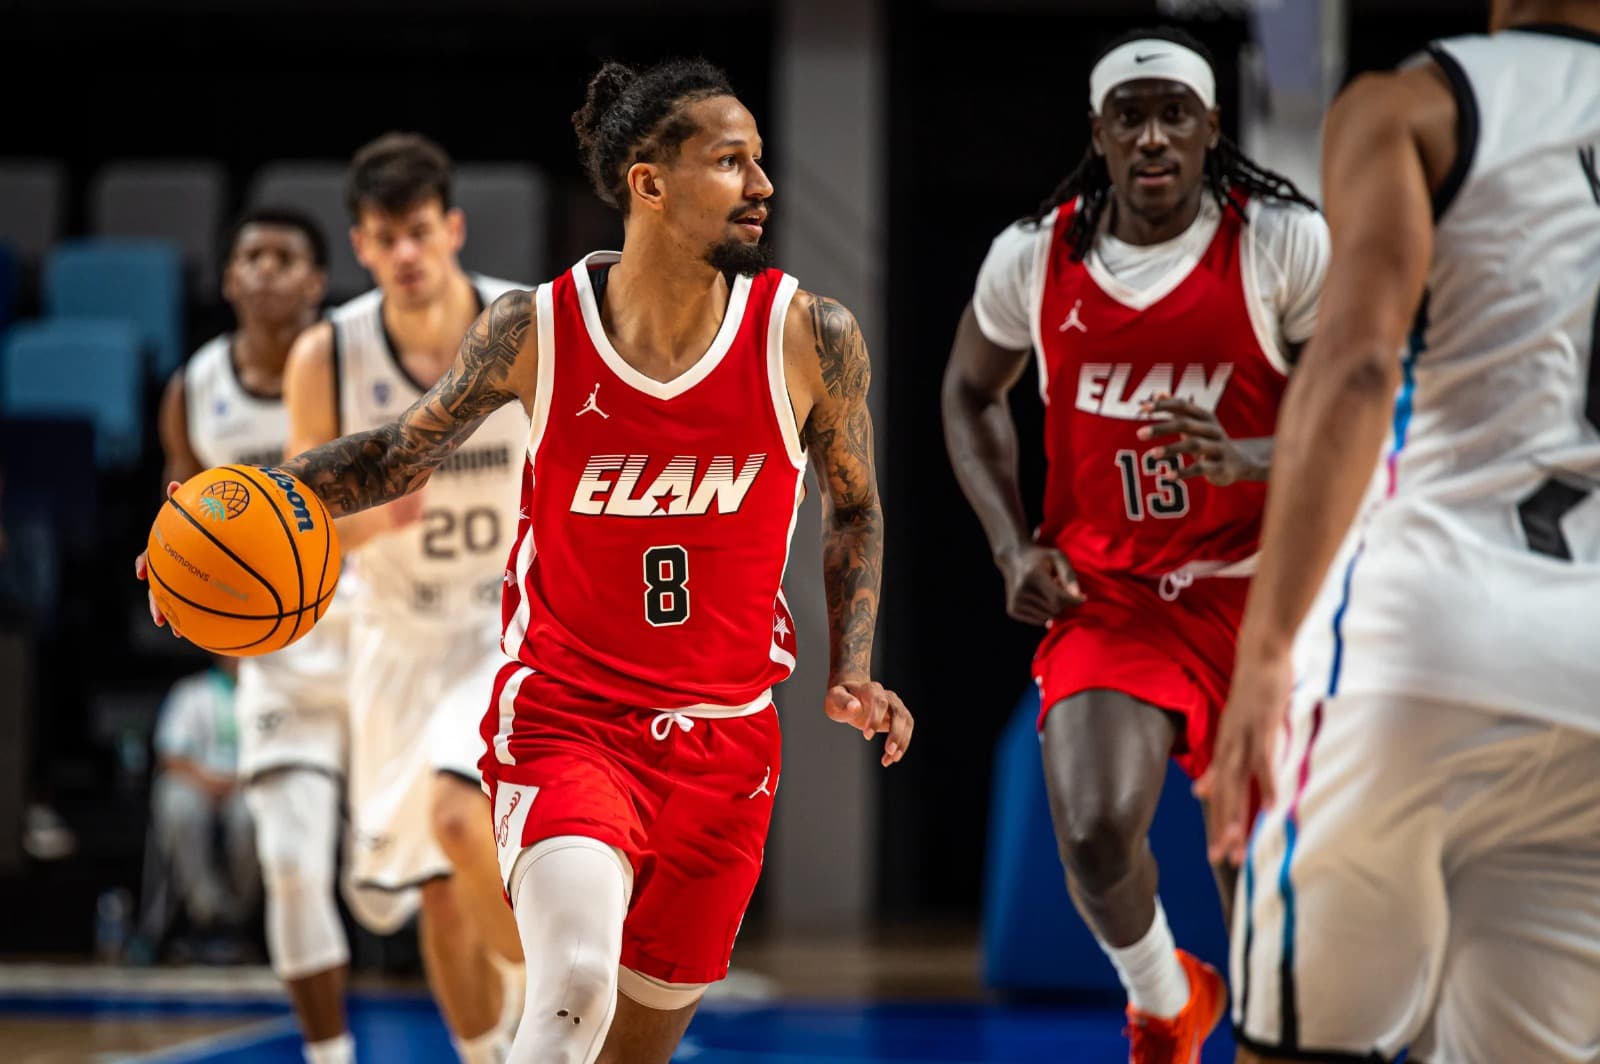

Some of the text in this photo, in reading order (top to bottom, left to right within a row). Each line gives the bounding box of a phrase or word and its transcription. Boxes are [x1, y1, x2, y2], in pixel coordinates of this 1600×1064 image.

[1075, 361, 1234, 421] ELAN
[569, 453, 767, 516] ELAN
[1115, 449, 1190, 521] 13
[164, 543, 211, 582] CHAMPIONS
[421, 505, 502, 560] 20
[643, 544, 690, 627] 8
